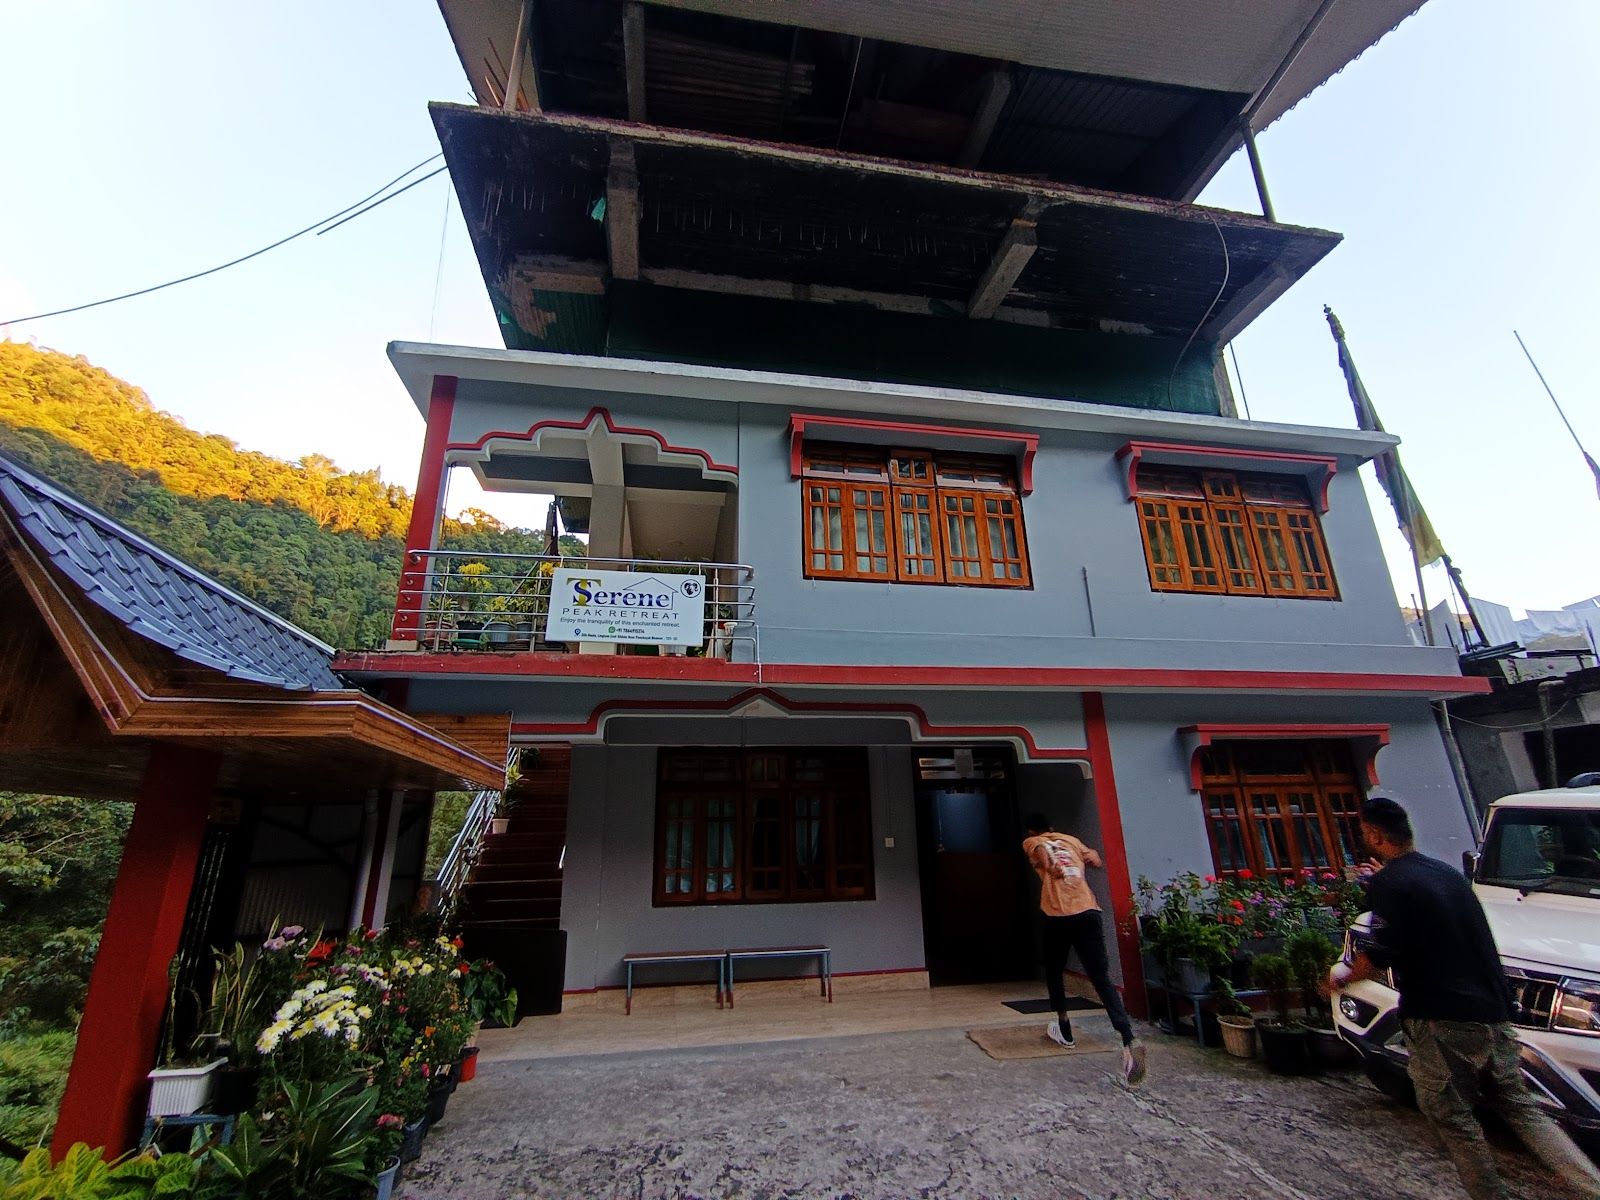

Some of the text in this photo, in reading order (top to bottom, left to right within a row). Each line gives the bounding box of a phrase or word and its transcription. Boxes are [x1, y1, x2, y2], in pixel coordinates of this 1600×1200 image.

[562, 607, 680, 620] PEAK RETREAT
[587, 618, 614, 626] tranquility
